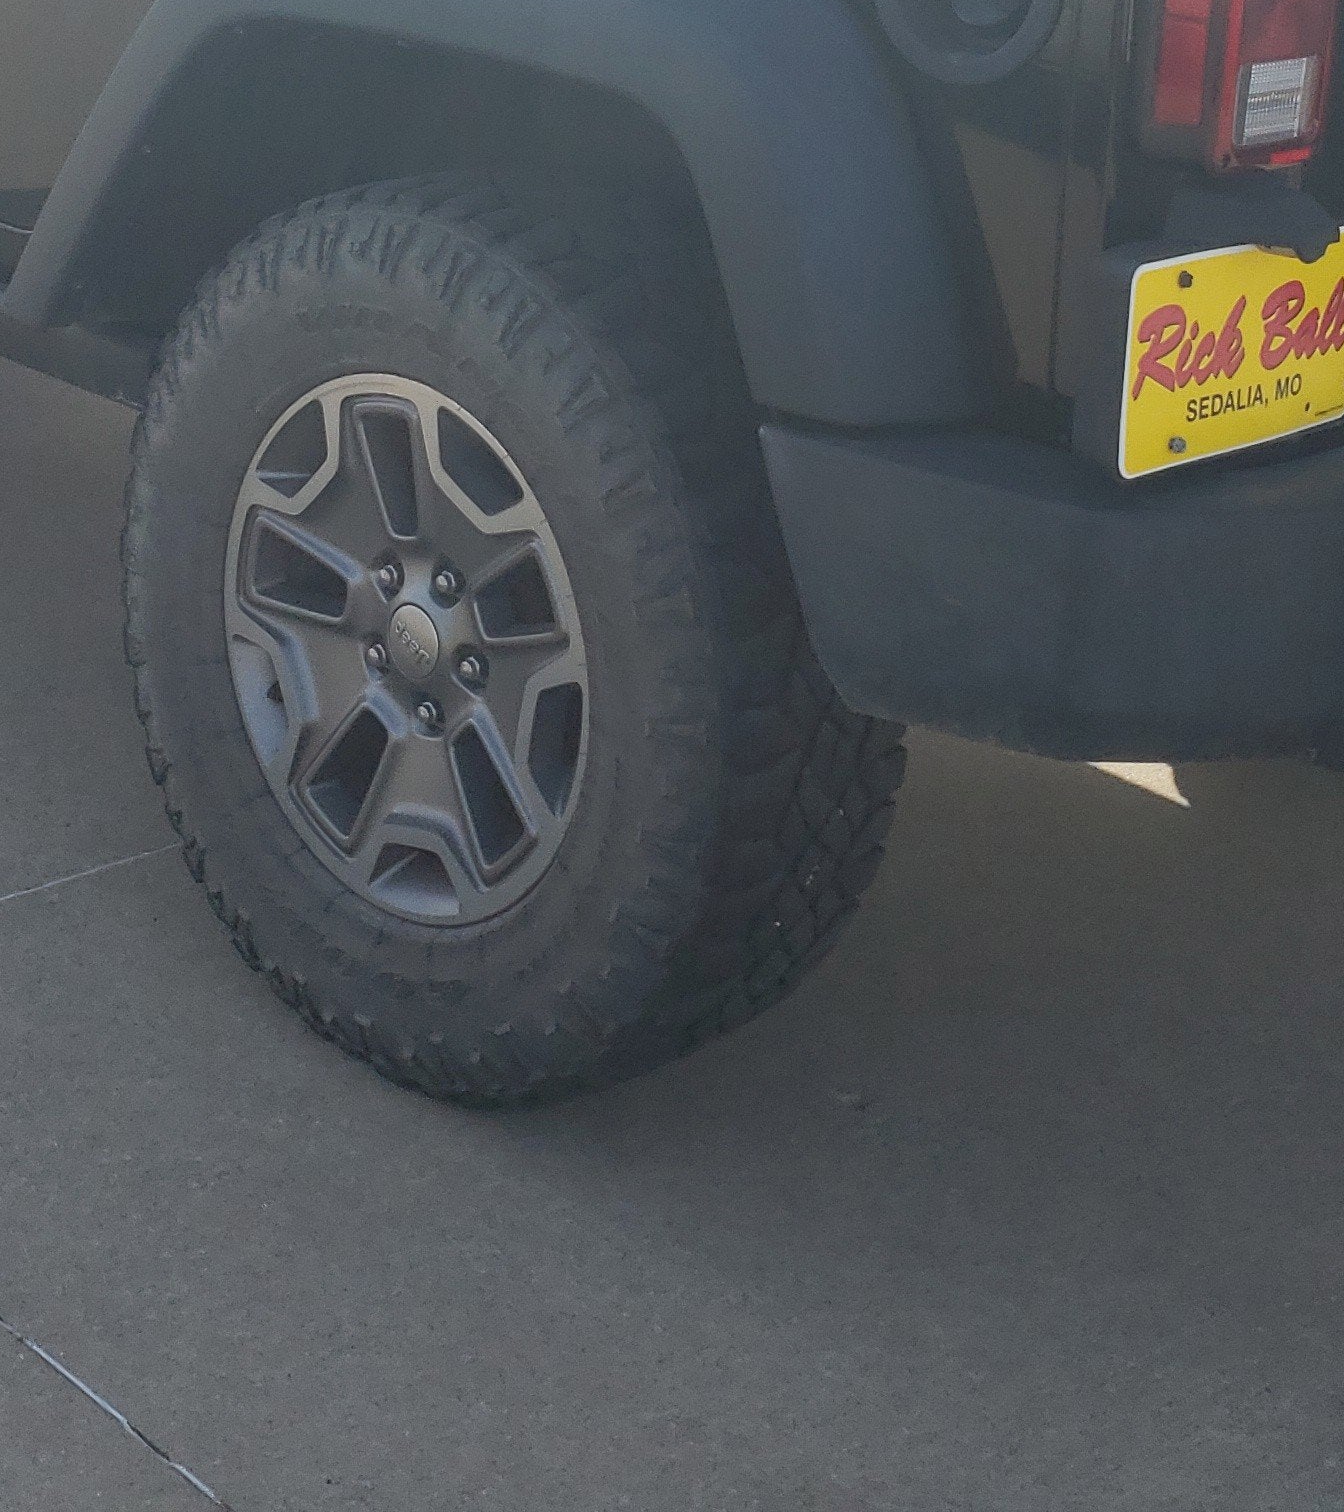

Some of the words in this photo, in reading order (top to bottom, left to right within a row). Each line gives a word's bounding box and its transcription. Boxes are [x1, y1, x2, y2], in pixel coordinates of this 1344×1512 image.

[1132, 295, 1246, 401] Rick
[1186, 384, 1268, 422] SEDALIA,
[1274, 373, 1302, 401] MO
